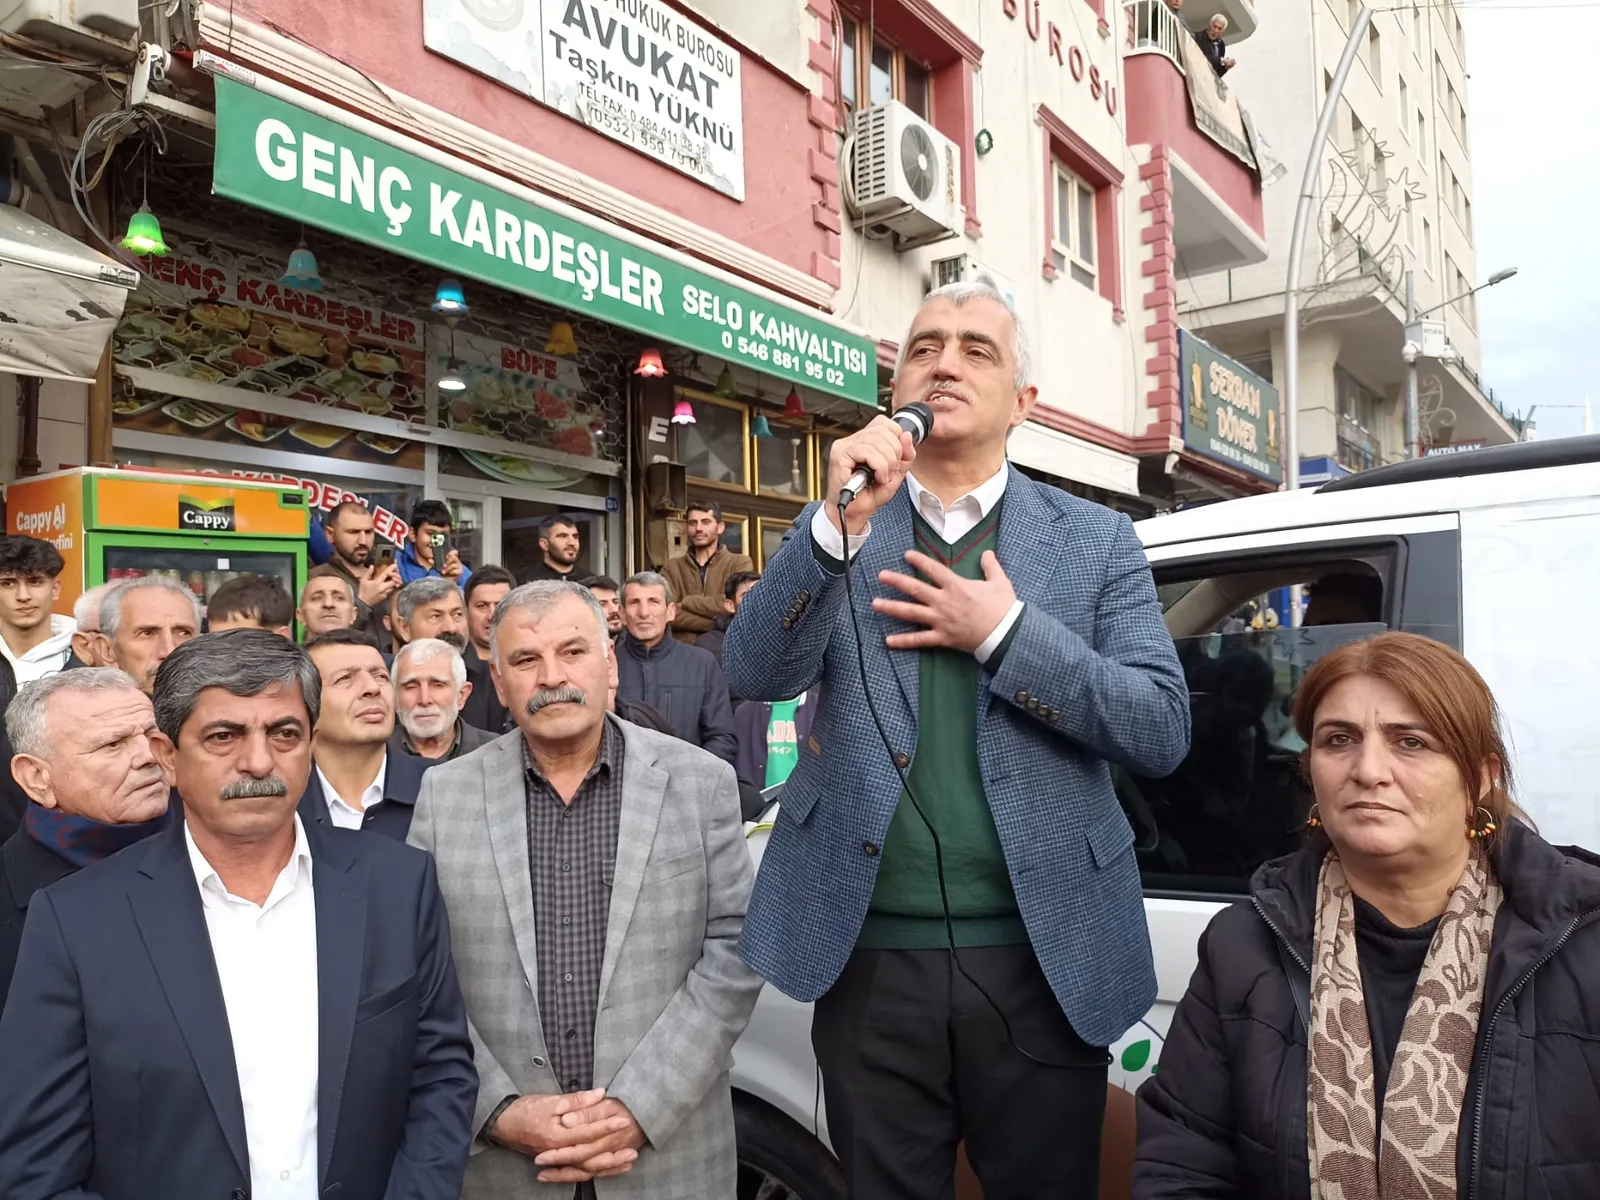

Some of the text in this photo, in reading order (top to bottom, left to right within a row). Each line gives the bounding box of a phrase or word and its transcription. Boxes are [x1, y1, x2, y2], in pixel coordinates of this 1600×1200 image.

[549, 29, 734, 152] Taşkın YÜKNÜ
[562, 0, 719, 109] AVUKAT
[255, 118, 665, 316] GENÇ KARDEŞLER
[682, 284, 867, 376] SELO KAHVALTISI
[721, 331, 845, 387] 0 546 881 95 02
[16, 510, 52, 534] Cappy
[183, 510, 230, 529] Cappy
